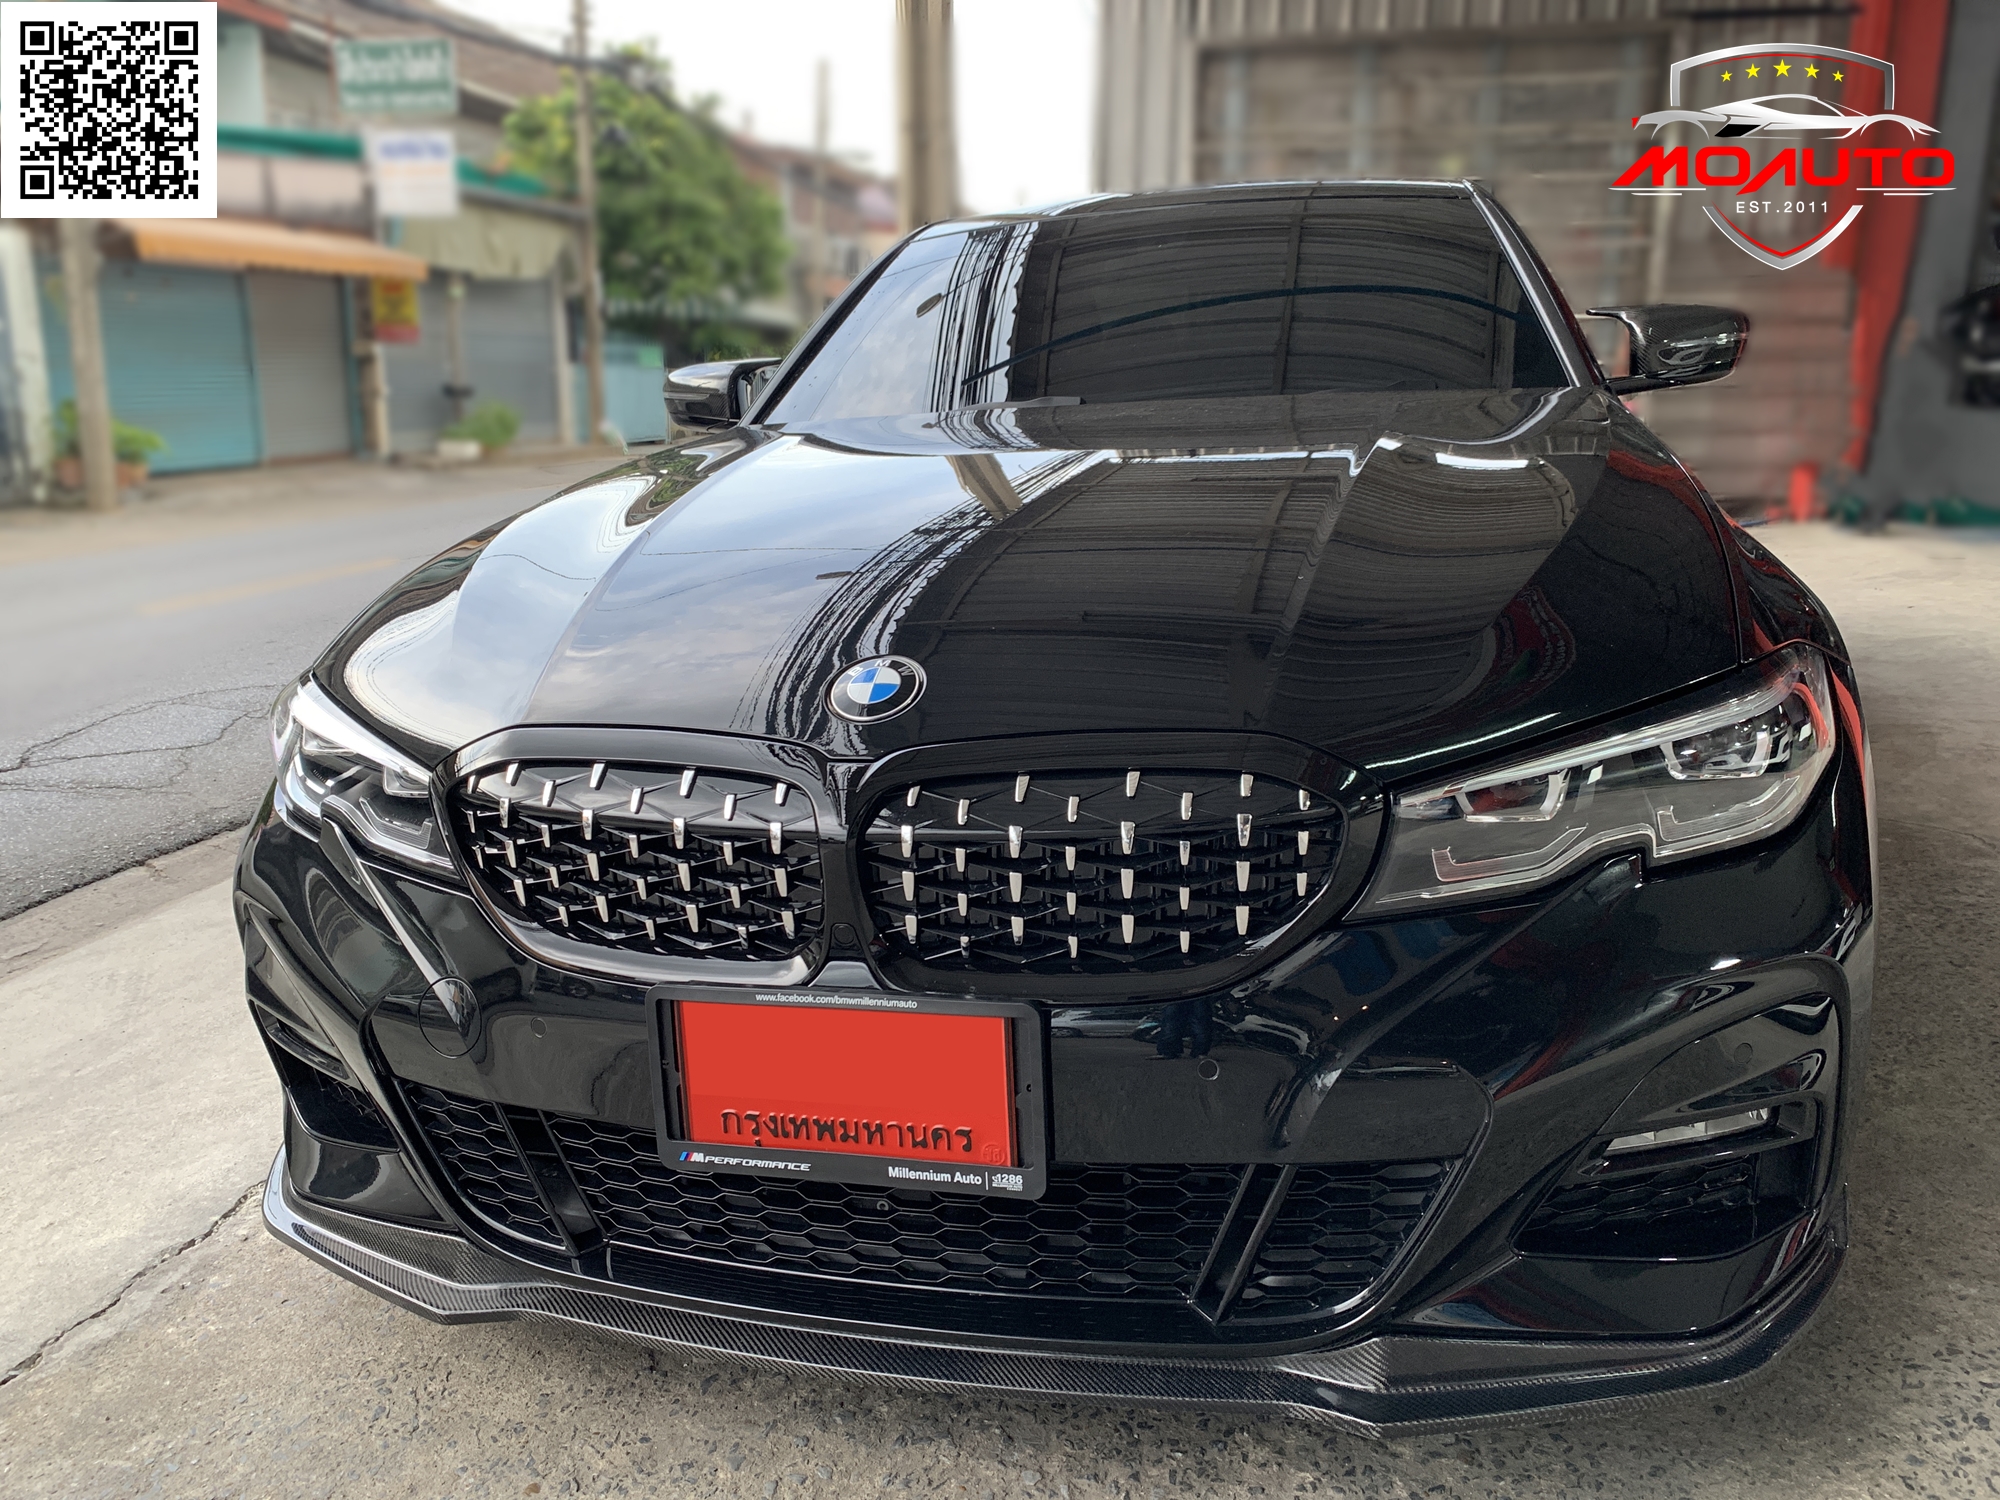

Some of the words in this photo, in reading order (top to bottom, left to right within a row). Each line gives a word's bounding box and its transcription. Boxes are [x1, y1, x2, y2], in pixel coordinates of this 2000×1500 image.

[848, 659, 914, 676] BMW
[755, 992, 918, 1009] www.facebook.com/bmwmillenniumauto
[720, 1108, 972, 1152] กรุงเทพมหานคร
[888, 1166, 951, 1182] Millennium
[953, 1172, 982, 1185] Auto
[996, 1173, 1023, 1184] 1286
